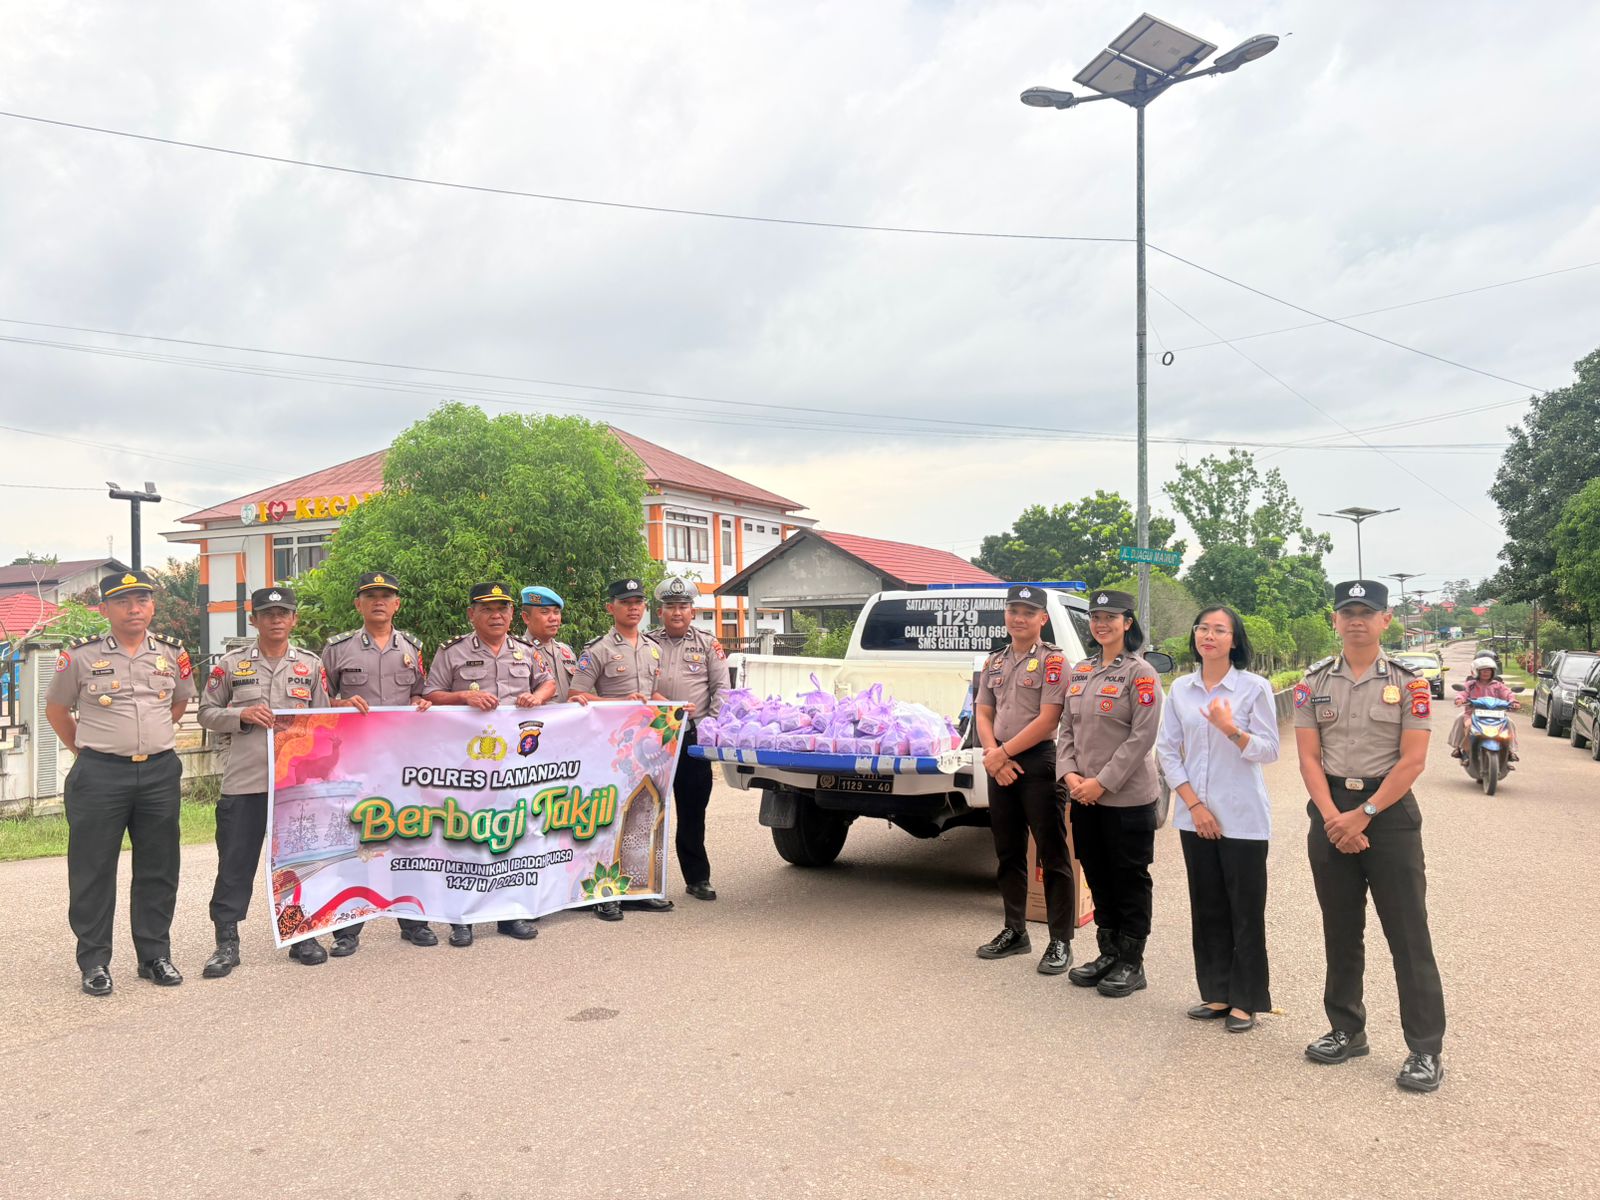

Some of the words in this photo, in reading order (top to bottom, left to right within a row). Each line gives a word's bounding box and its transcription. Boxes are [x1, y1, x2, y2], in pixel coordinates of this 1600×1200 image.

[294, 491, 384, 520] KECA
[906, 599, 943, 611] SATLANTAS
[943, 599, 970, 611] POLRES
[934, 610, 979, 626] 1129
[904, 625, 925, 638] CALL
[926, 625, 959, 638] CENTER
[960, 625, 987, 638] 1-500
[988, 625, 1008, 638] 669
[918, 637, 937, 650] SMS
[938, 637, 970, 650] CENTER
[971, 637, 992, 650] 9119
[287, 677, 312, 686] POLRI
[403, 767, 486, 789] POLRES
[491, 760, 581, 788] LAMANDAU
[842, 780, 863, 790] 1129
[351, 797, 526, 854] Berbagi
[531, 784, 618, 840] Takjil
[391, 857, 443, 871] SELAMAT
[545, 849, 573, 866] PUASA
[446, 875, 476, 890] 1447
[477, 878, 488, 892] H
[496, 872, 524, 889] 2026
[526, 871, 538, 885] M
